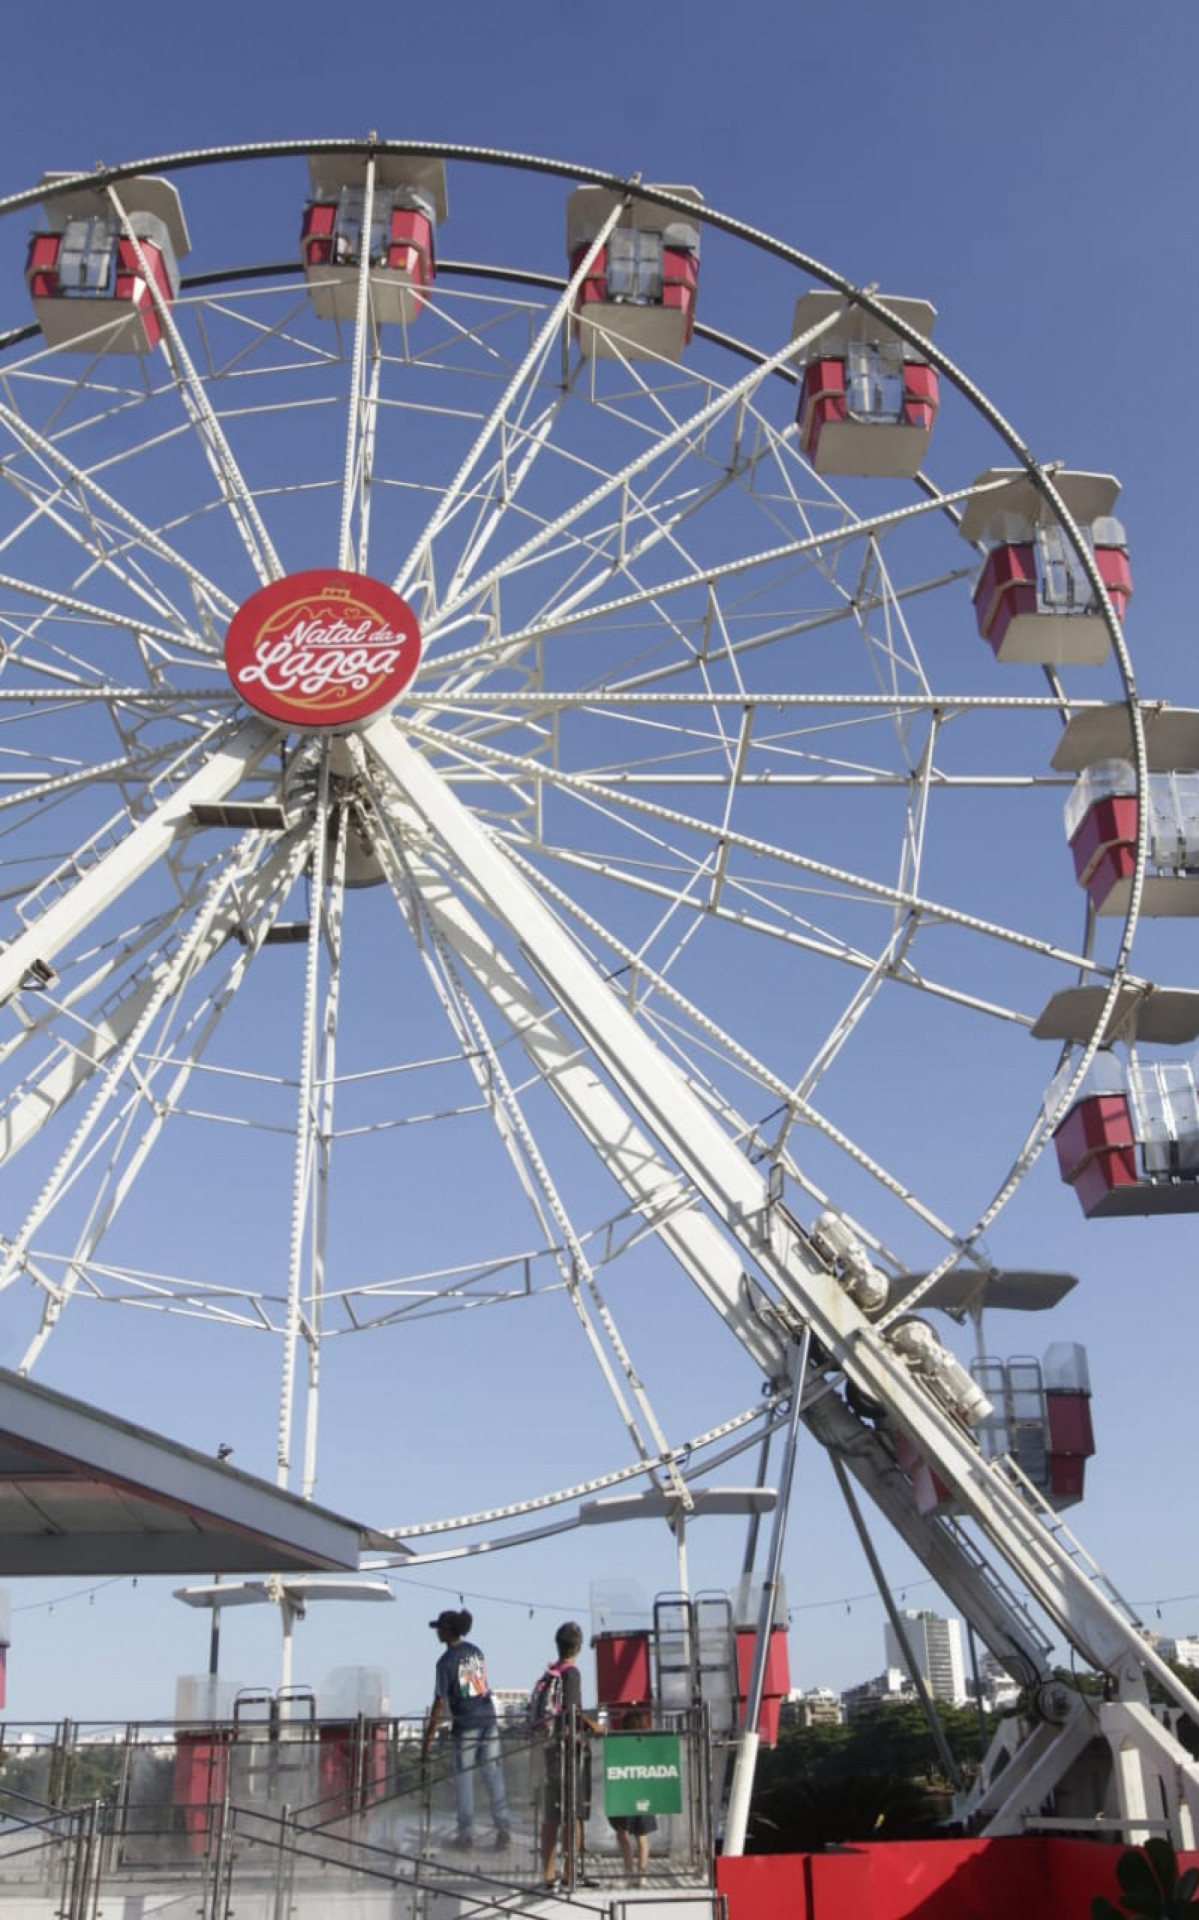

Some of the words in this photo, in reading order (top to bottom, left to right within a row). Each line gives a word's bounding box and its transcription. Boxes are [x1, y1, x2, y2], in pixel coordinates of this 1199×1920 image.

[284, 619, 372, 646] Natal
[368, 623, 396, 643] da
[238, 641, 401, 694] Lagoa
[606, 1765, 679, 1780] ENTRADA
